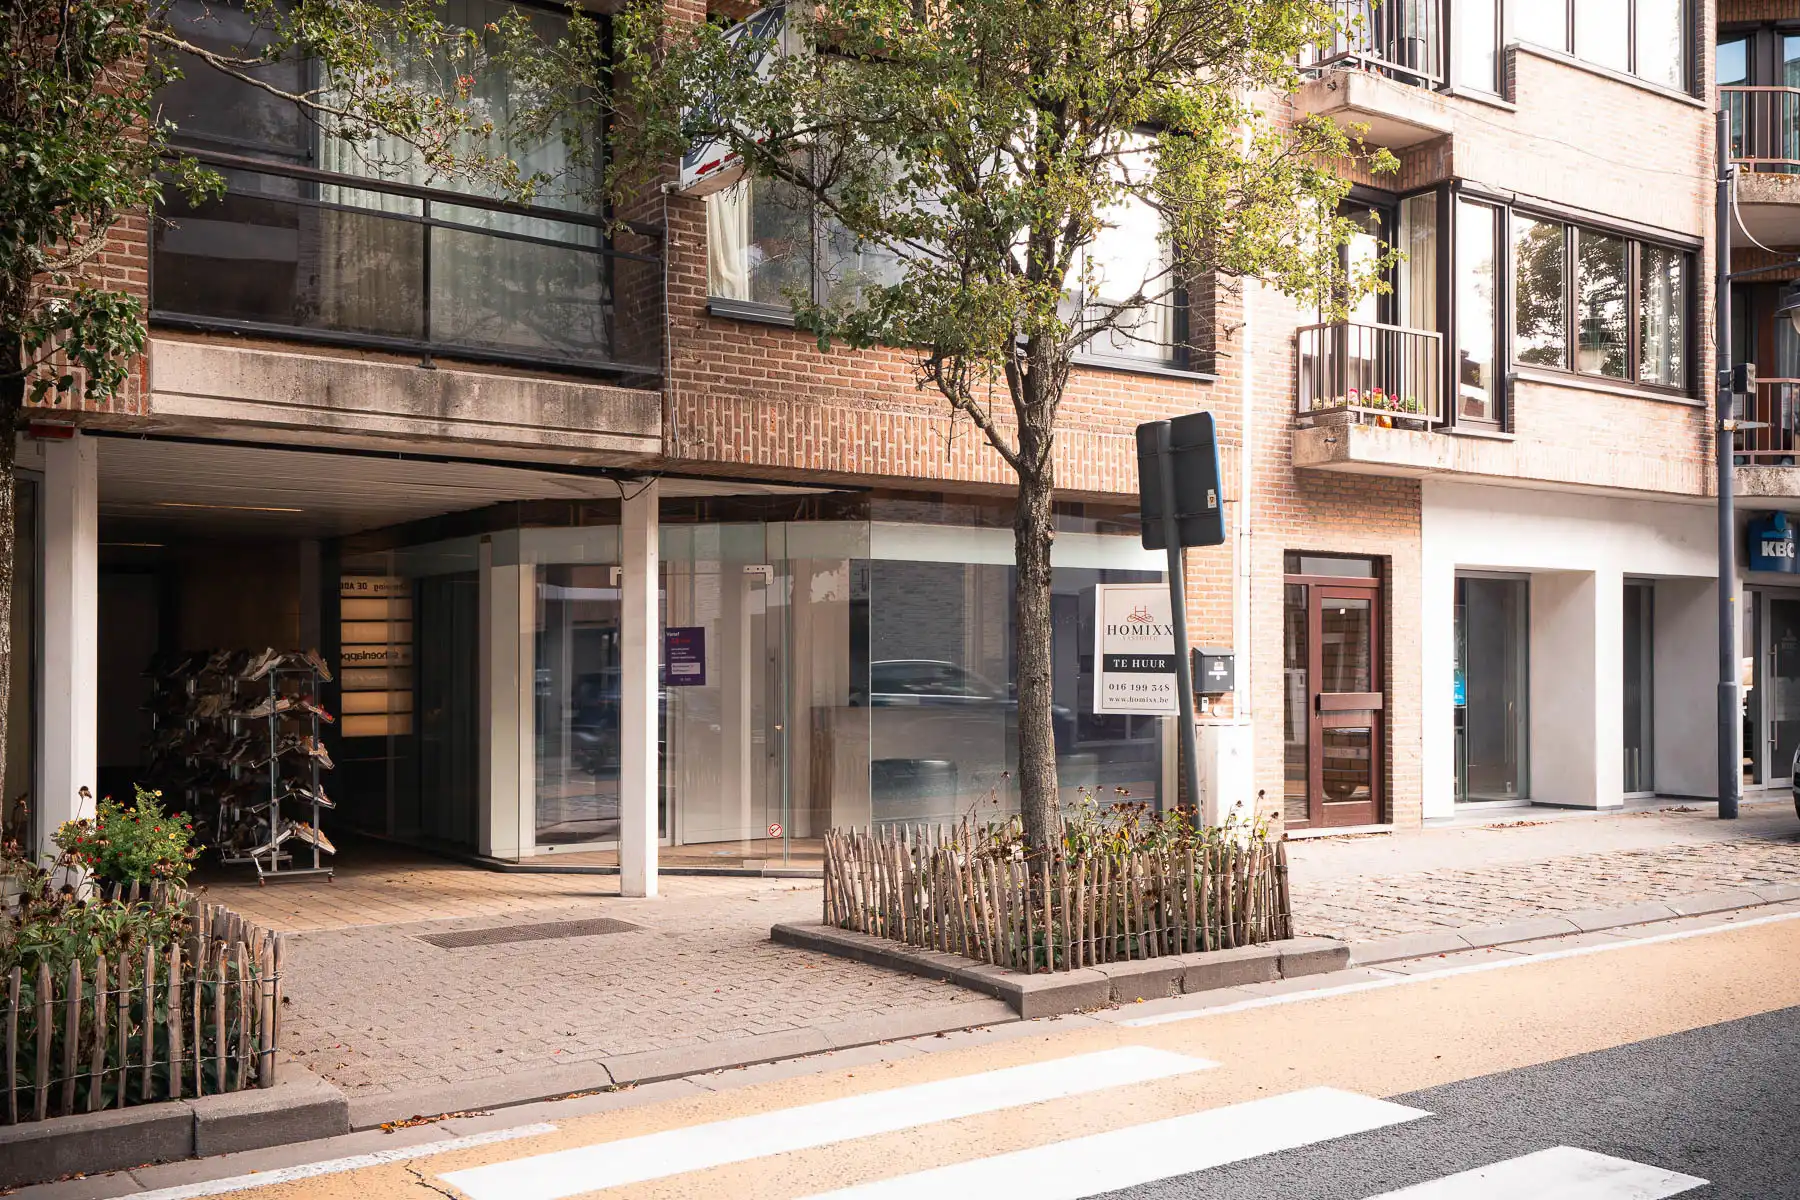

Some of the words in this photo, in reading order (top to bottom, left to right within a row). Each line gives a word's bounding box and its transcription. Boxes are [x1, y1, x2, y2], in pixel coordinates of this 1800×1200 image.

[1761, 540, 1795, 557] KBC
[1107, 624, 1174, 636] HOMIXX
[1113, 659, 1128, 668] TE
[1132, 659, 1166, 668] HUUR
[1108, 683, 1127, 691] 016
[1131, 684, 1148, 692] 199
[1151, 683, 1170, 692] 348
[1108, 696, 1169, 704] www.homixx.be
